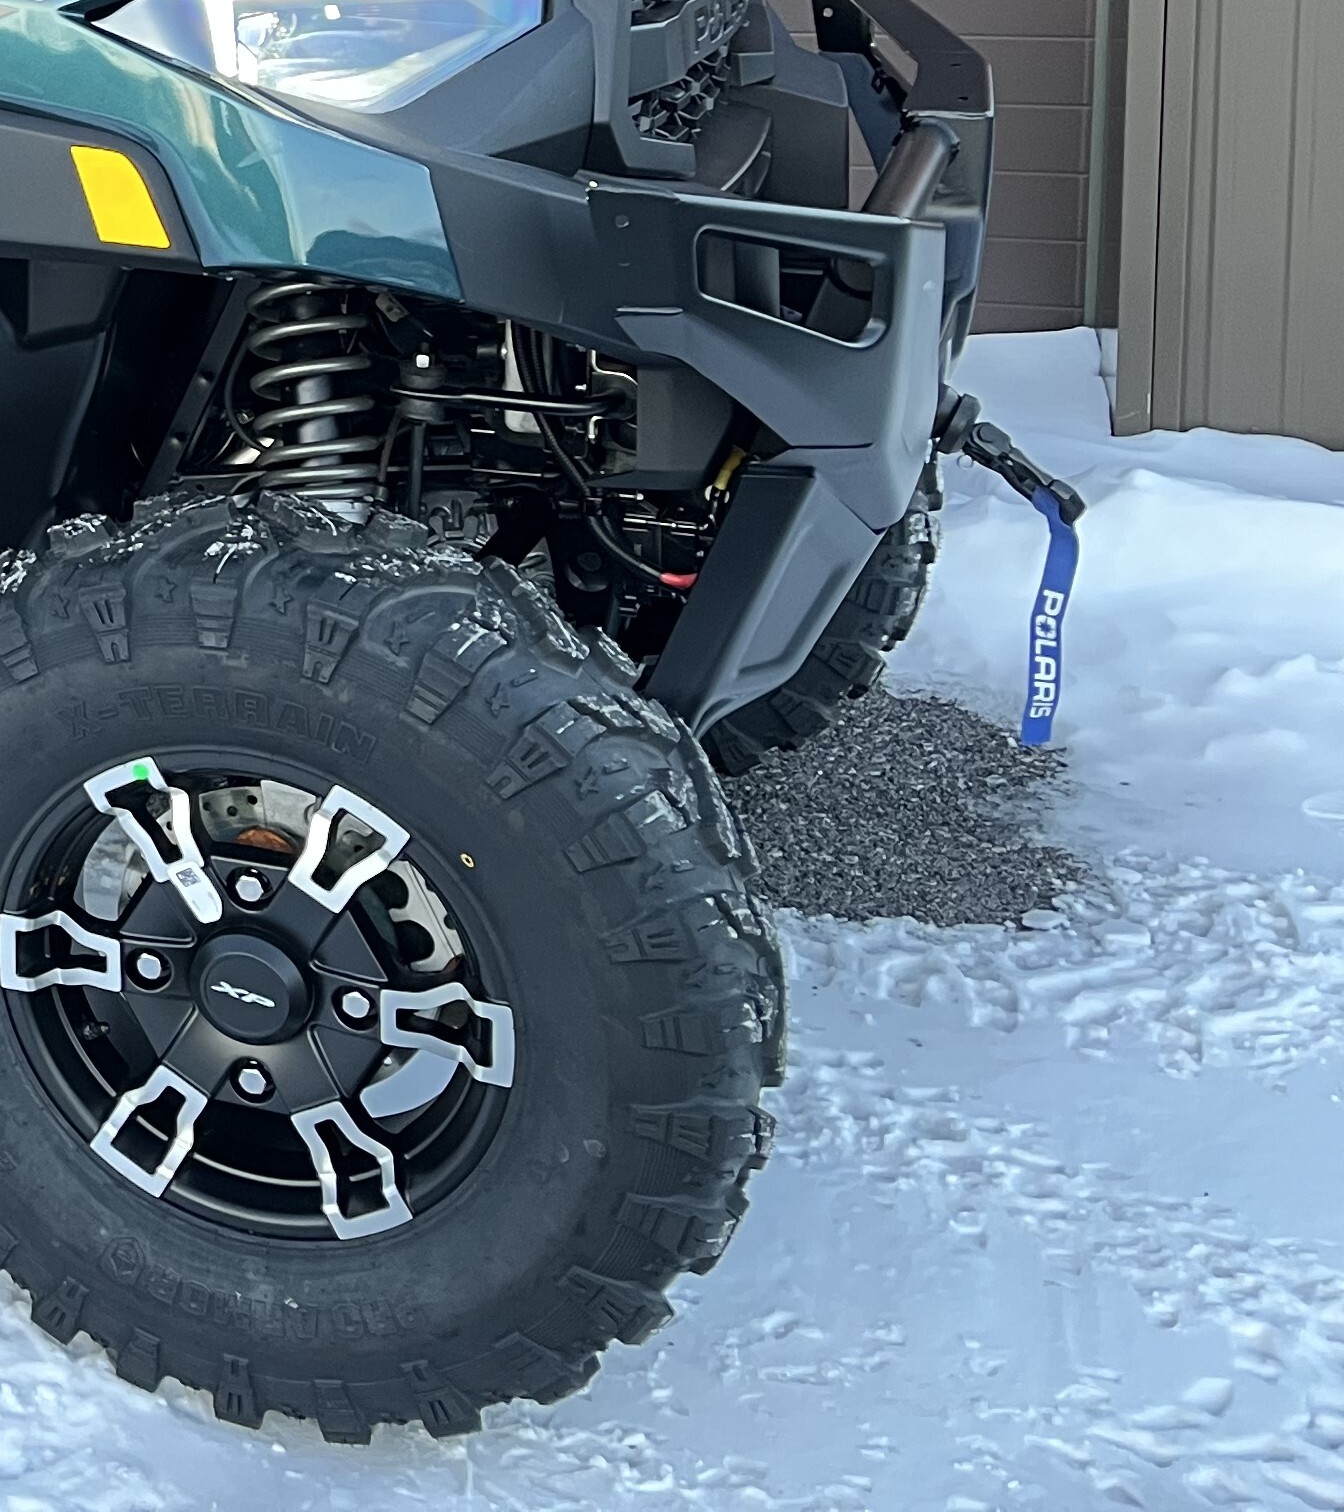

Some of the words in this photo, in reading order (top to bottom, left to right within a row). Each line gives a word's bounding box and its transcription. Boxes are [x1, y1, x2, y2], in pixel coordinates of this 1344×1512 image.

[1029, 589, 1065, 719] POLARIS
[56, 685, 378, 763] X-TERRAIN
[210, 981, 275, 1008] XP
